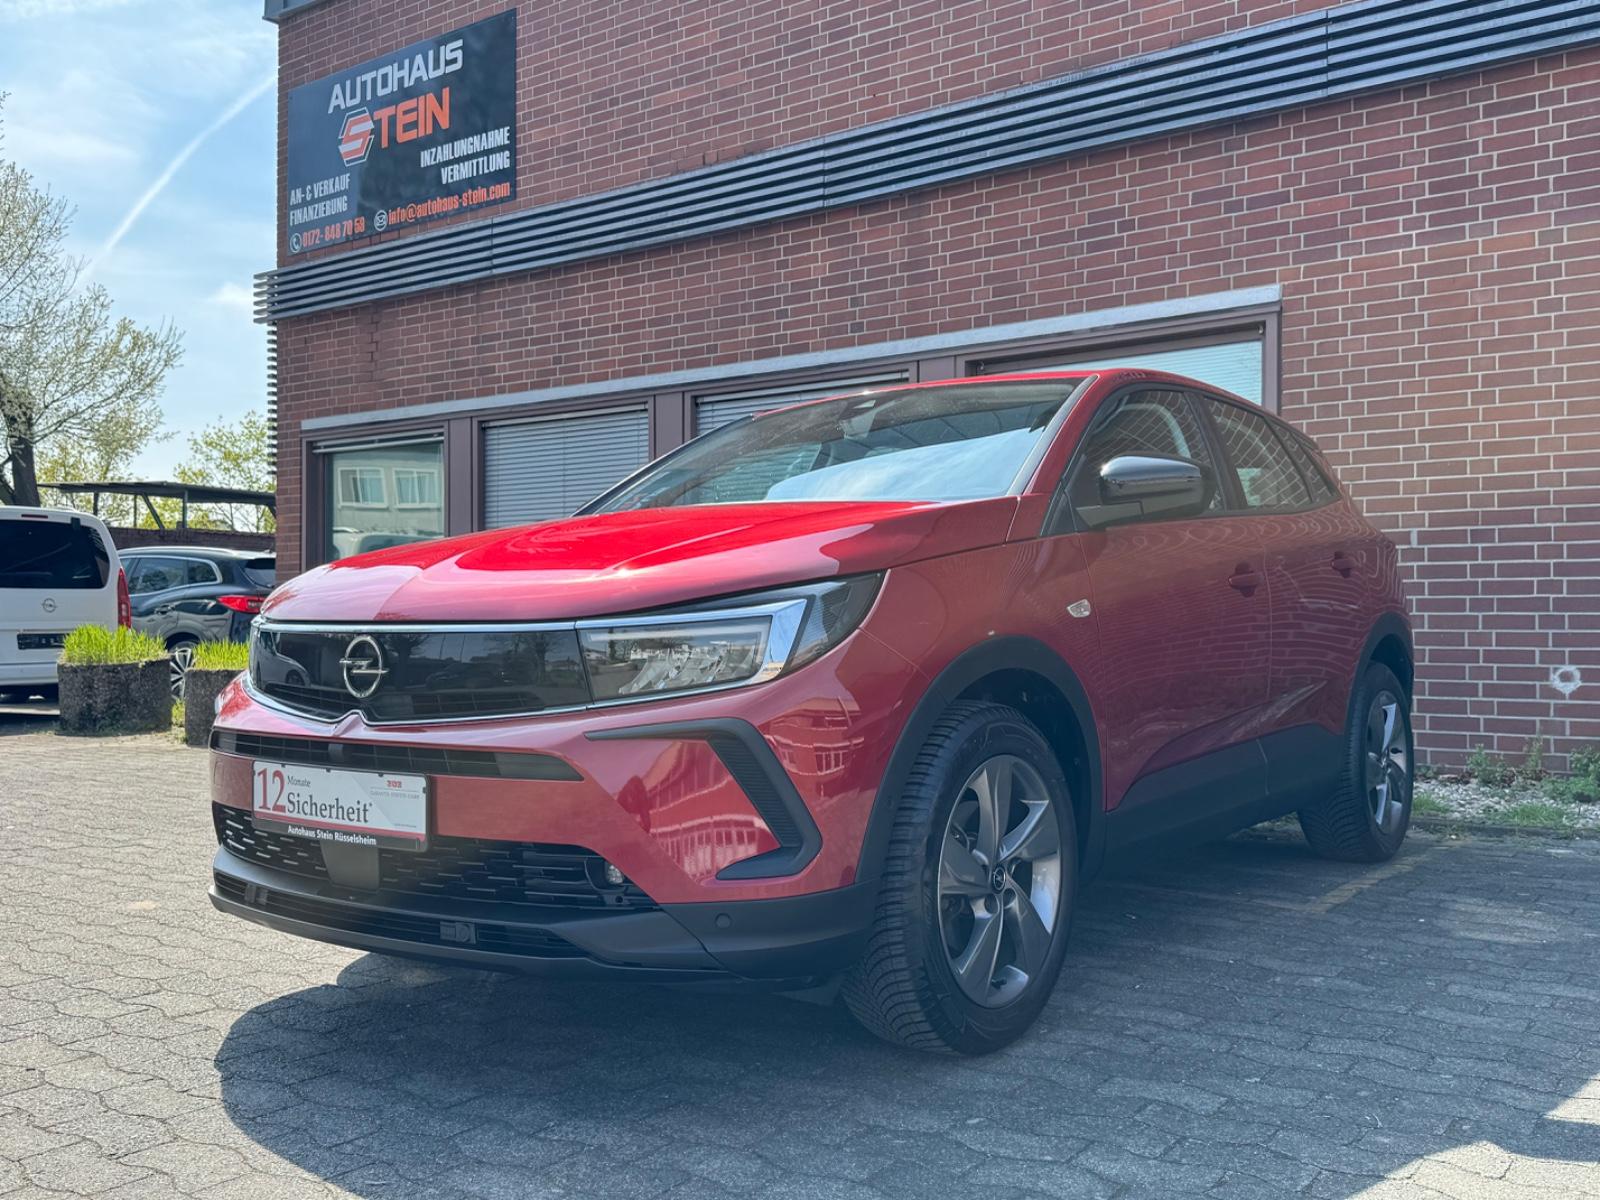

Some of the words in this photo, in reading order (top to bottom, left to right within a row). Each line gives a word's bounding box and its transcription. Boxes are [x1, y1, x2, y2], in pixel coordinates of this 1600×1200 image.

[328, 39, 463, 114] AUTOHAUS
[339, 87, 450, 166] STEIN
[420, 126, 511, 168] INZAHLUNGNAHME
[440, 150, 511, 185] VERMITTLUNG
[305, 185, 313, 201] &
[313, 173, 351, 198] VERKAUF
[388, 182, 511, 225] info@autohaus-stein.com
[289, 195, 348, 226] FINANZIERUNG
[257, 768, 286, 813] 12
[287, 775, 311, 788] Monate
[287, 825, 315, 838] Autohaus
[316, 829, 333, 840] Stein
[334, 832, 377, 846] Rüsselsheim
